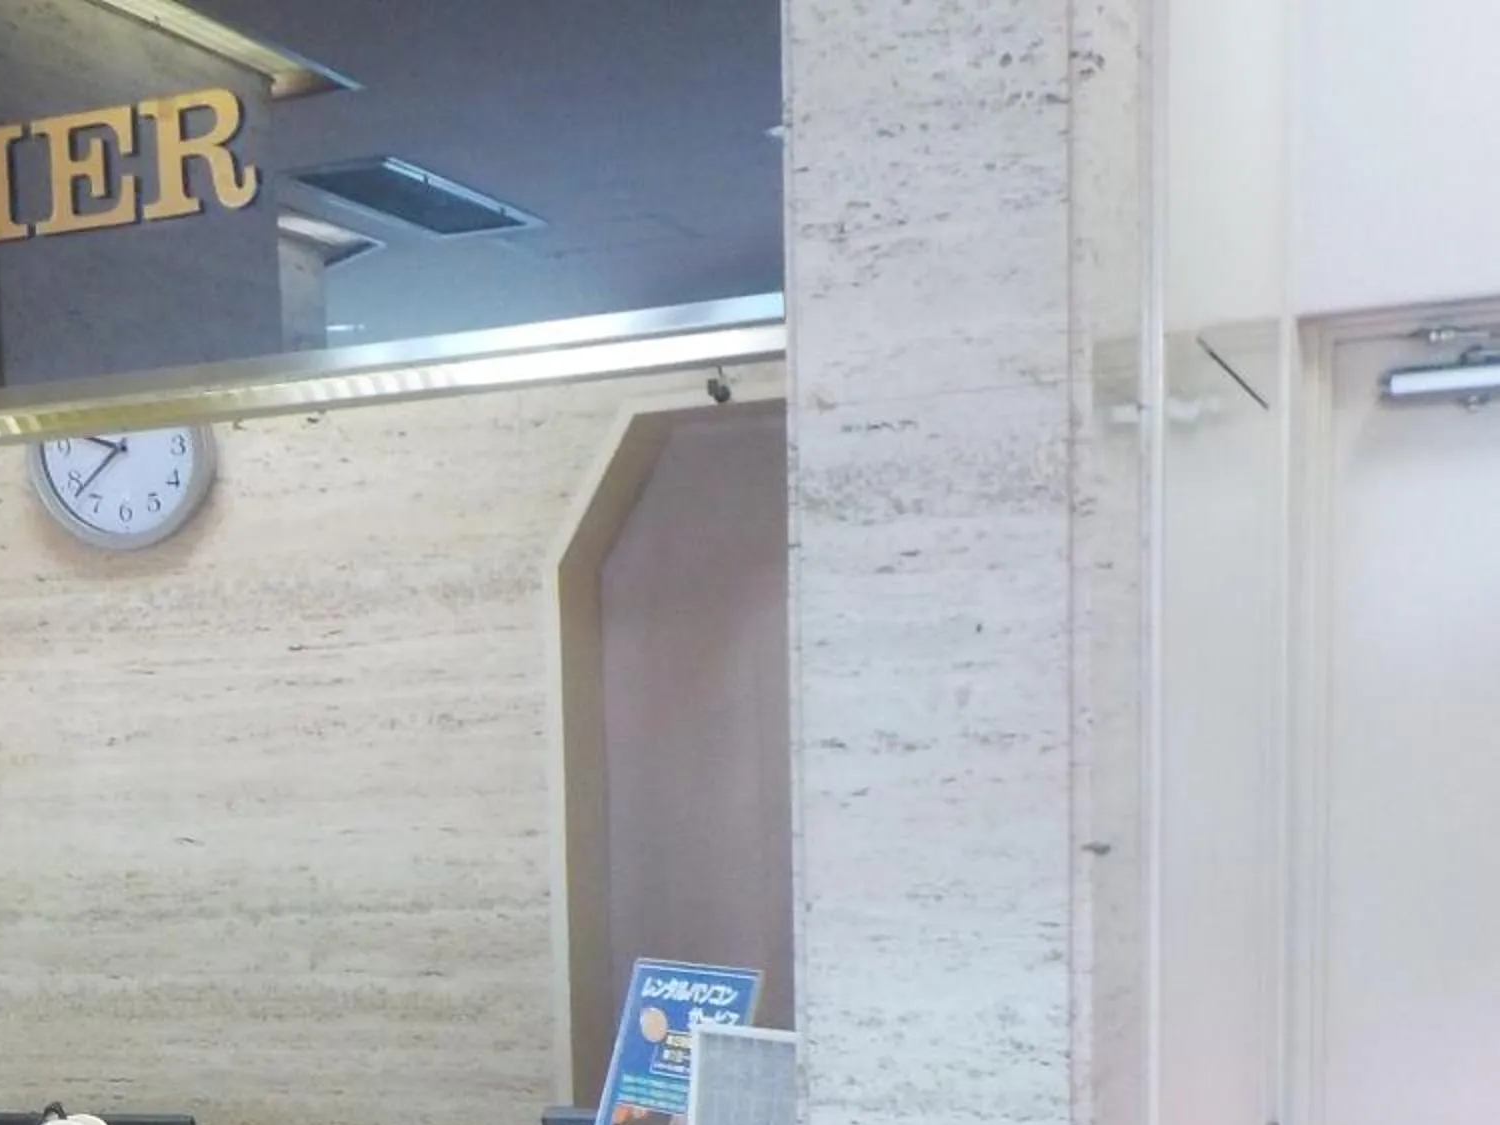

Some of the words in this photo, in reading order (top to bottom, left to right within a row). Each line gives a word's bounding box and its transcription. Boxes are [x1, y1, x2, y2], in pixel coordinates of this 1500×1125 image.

[171, 434, 187, 456] 3
[67, 470, 85, 491] 8
[165, 468, 181, 488] 4
[88, 493, 103, 513] 7
[119, 503, 133, 523] 6
[147, 493, 162, 513] 5
